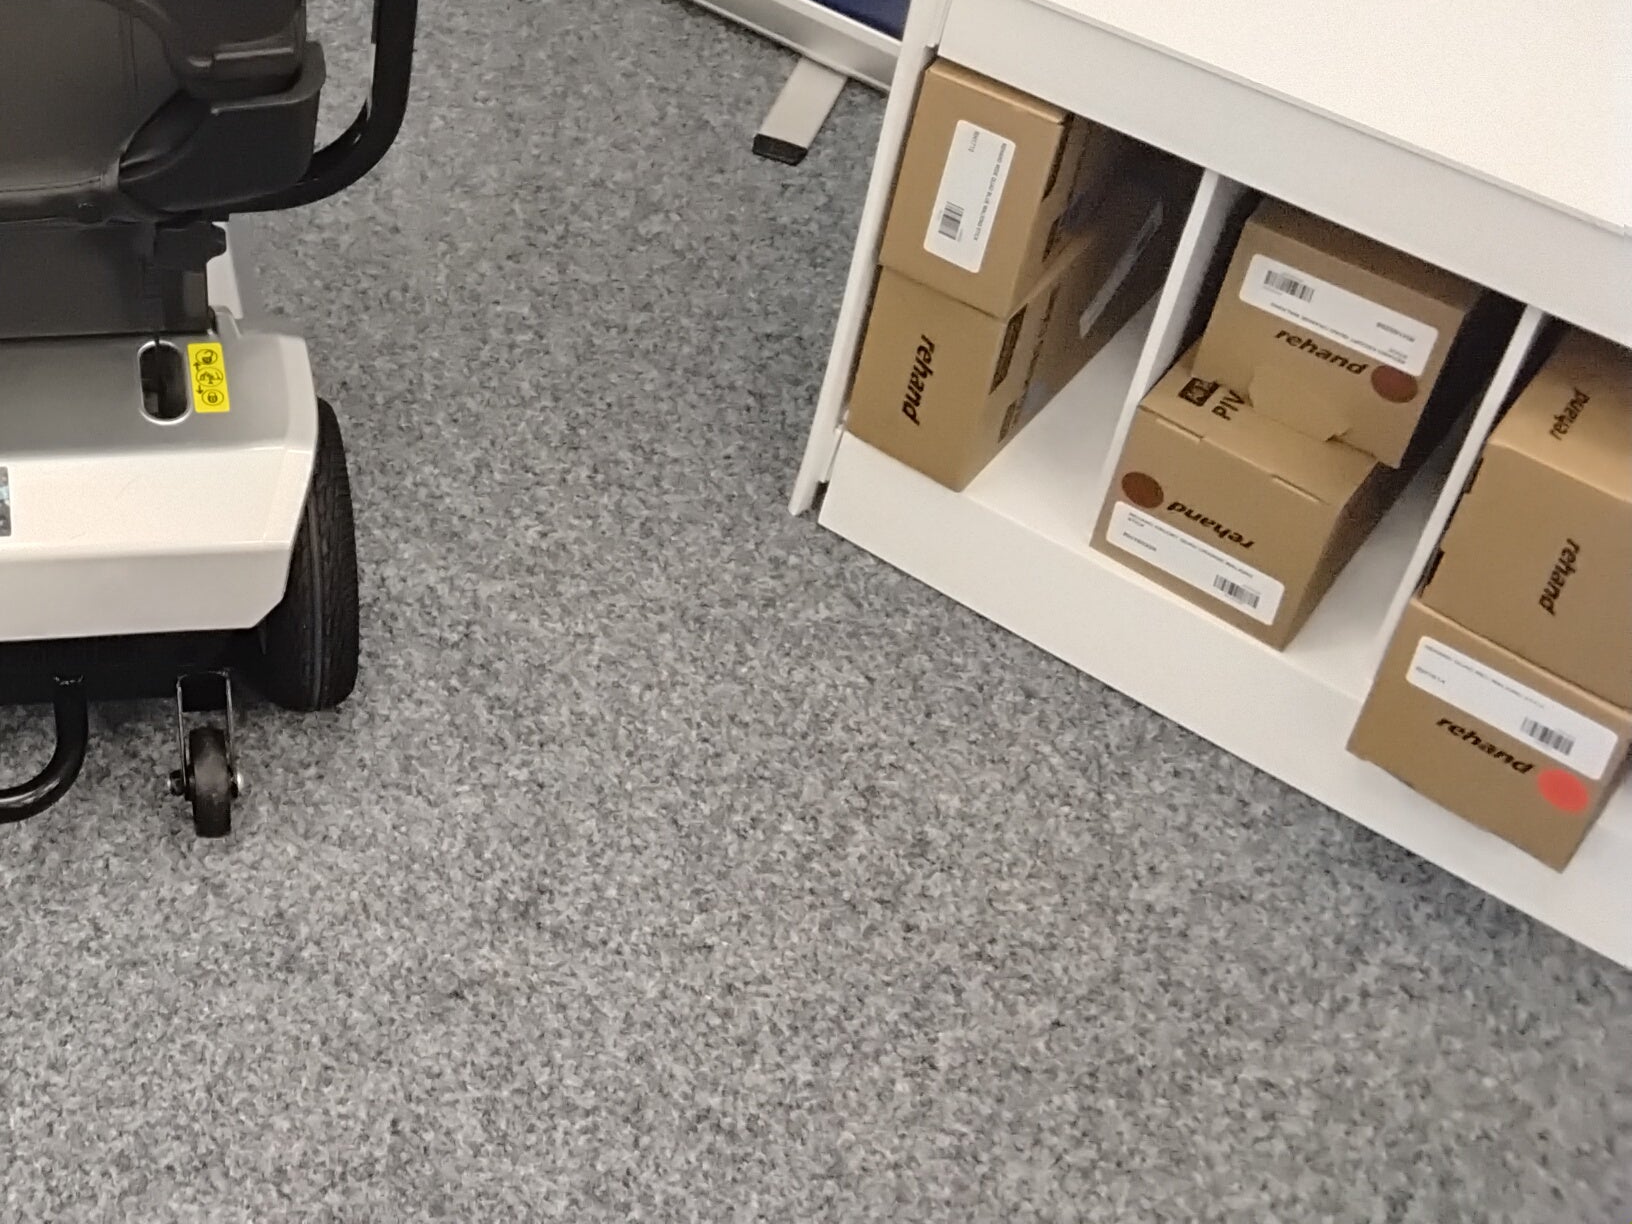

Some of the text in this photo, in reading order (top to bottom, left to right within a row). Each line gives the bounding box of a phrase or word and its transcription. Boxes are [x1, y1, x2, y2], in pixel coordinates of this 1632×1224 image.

[1274, 330, 1368, 375] rehand
[902, 334, 935, 426] rehand
[1211, 389, 1246, 422] PIV
[1549, 387, 1590, 440] rehand
[1166, 501, 1255, 549] rehand
[1539, 538, 1580, 616] rehand
[1435, 718, 1534, 774] rehand
